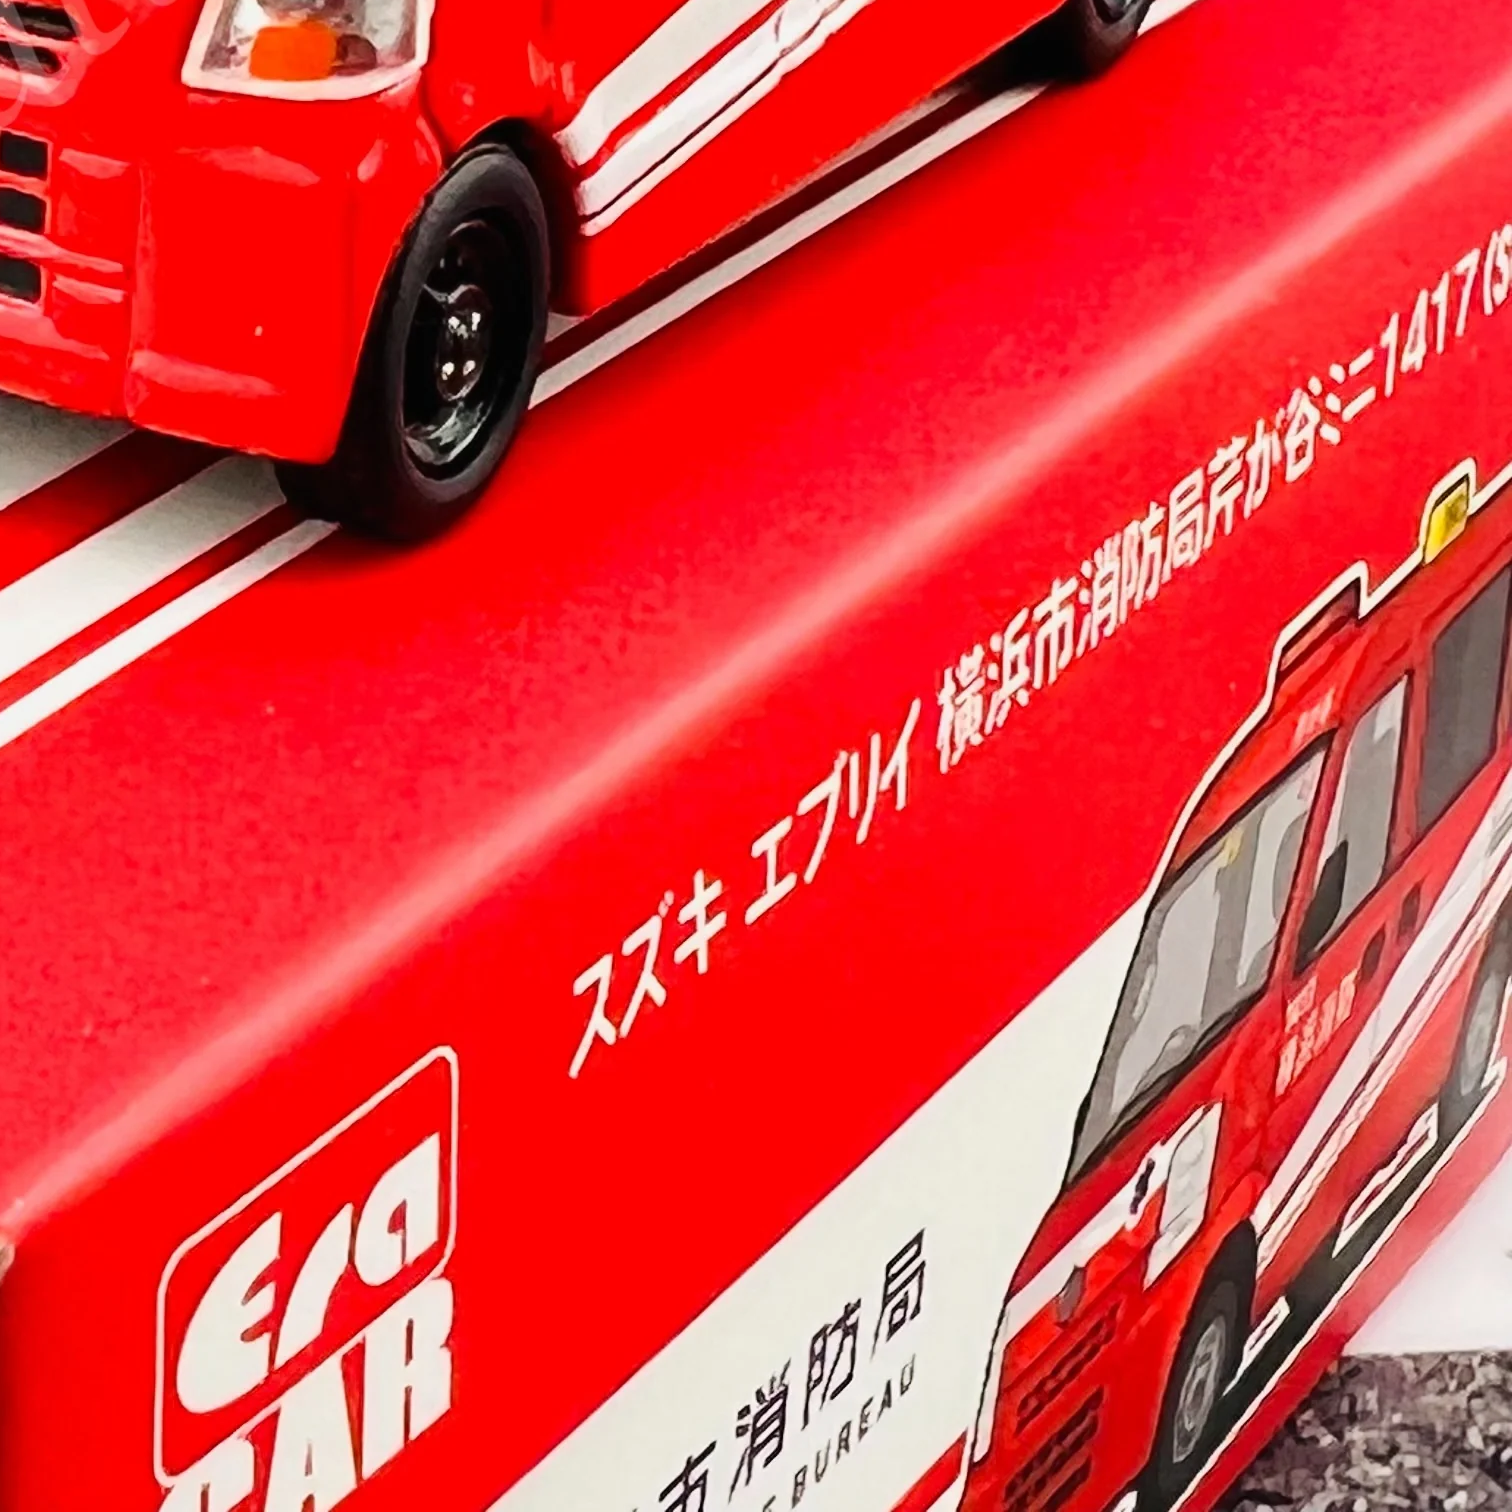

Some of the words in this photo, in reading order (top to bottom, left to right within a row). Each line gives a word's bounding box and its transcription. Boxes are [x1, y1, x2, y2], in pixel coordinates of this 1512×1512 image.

[569, 869, 727, 1079] スズキ
[745, 698, 921, 926] エブリイ
[936, 223, 1512, 774] 横浜市消防局芹が谷ミニ1417(S
[177, 1131, 440, 1414] Era
[791, 1354, 916, 1509] BUREAU
